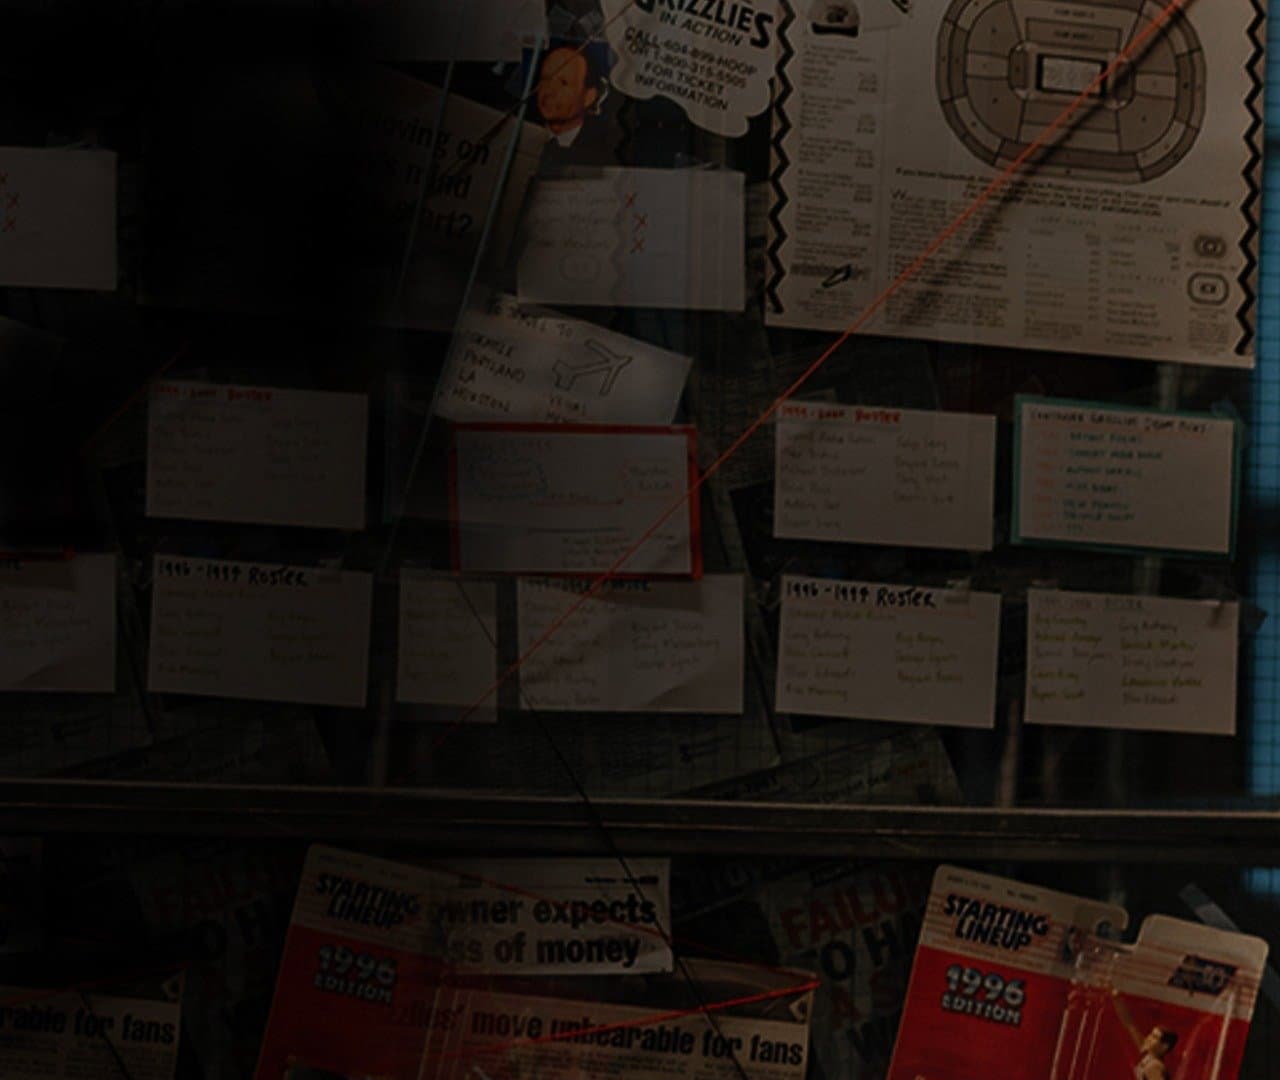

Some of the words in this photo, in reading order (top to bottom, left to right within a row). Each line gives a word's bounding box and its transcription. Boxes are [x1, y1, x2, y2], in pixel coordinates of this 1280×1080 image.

[625, 26, 660, 49] CALL
[660, 11, 677, 25] IN
[682, 19, 743, 46] ACTION
[635, 74, 728, 110] INFORMATION
[644, 62, 673, 78] FOR
[678, 70, 724, 95] TICKET
[533, 894, 656, 928] expects
[943, 894, 1049, 937] STARTING
[495, 932, 526, 964] of
[536, 938, 640, 968] money
[954, 914, 1032, 950] LINEUP
[318, 944, 397, 985] 1996
[313, 971, 394, 1005] EDITION
[945, 963, 1026, 1008] 1996
[941, 990, 1023, 1027] EDITION
[122, 1010, 177, 1045] fans
[471, 1009, 543, 1038] move
[703, 1029, 743, 1058] for
[750, 1034, 804, 1065] fans
